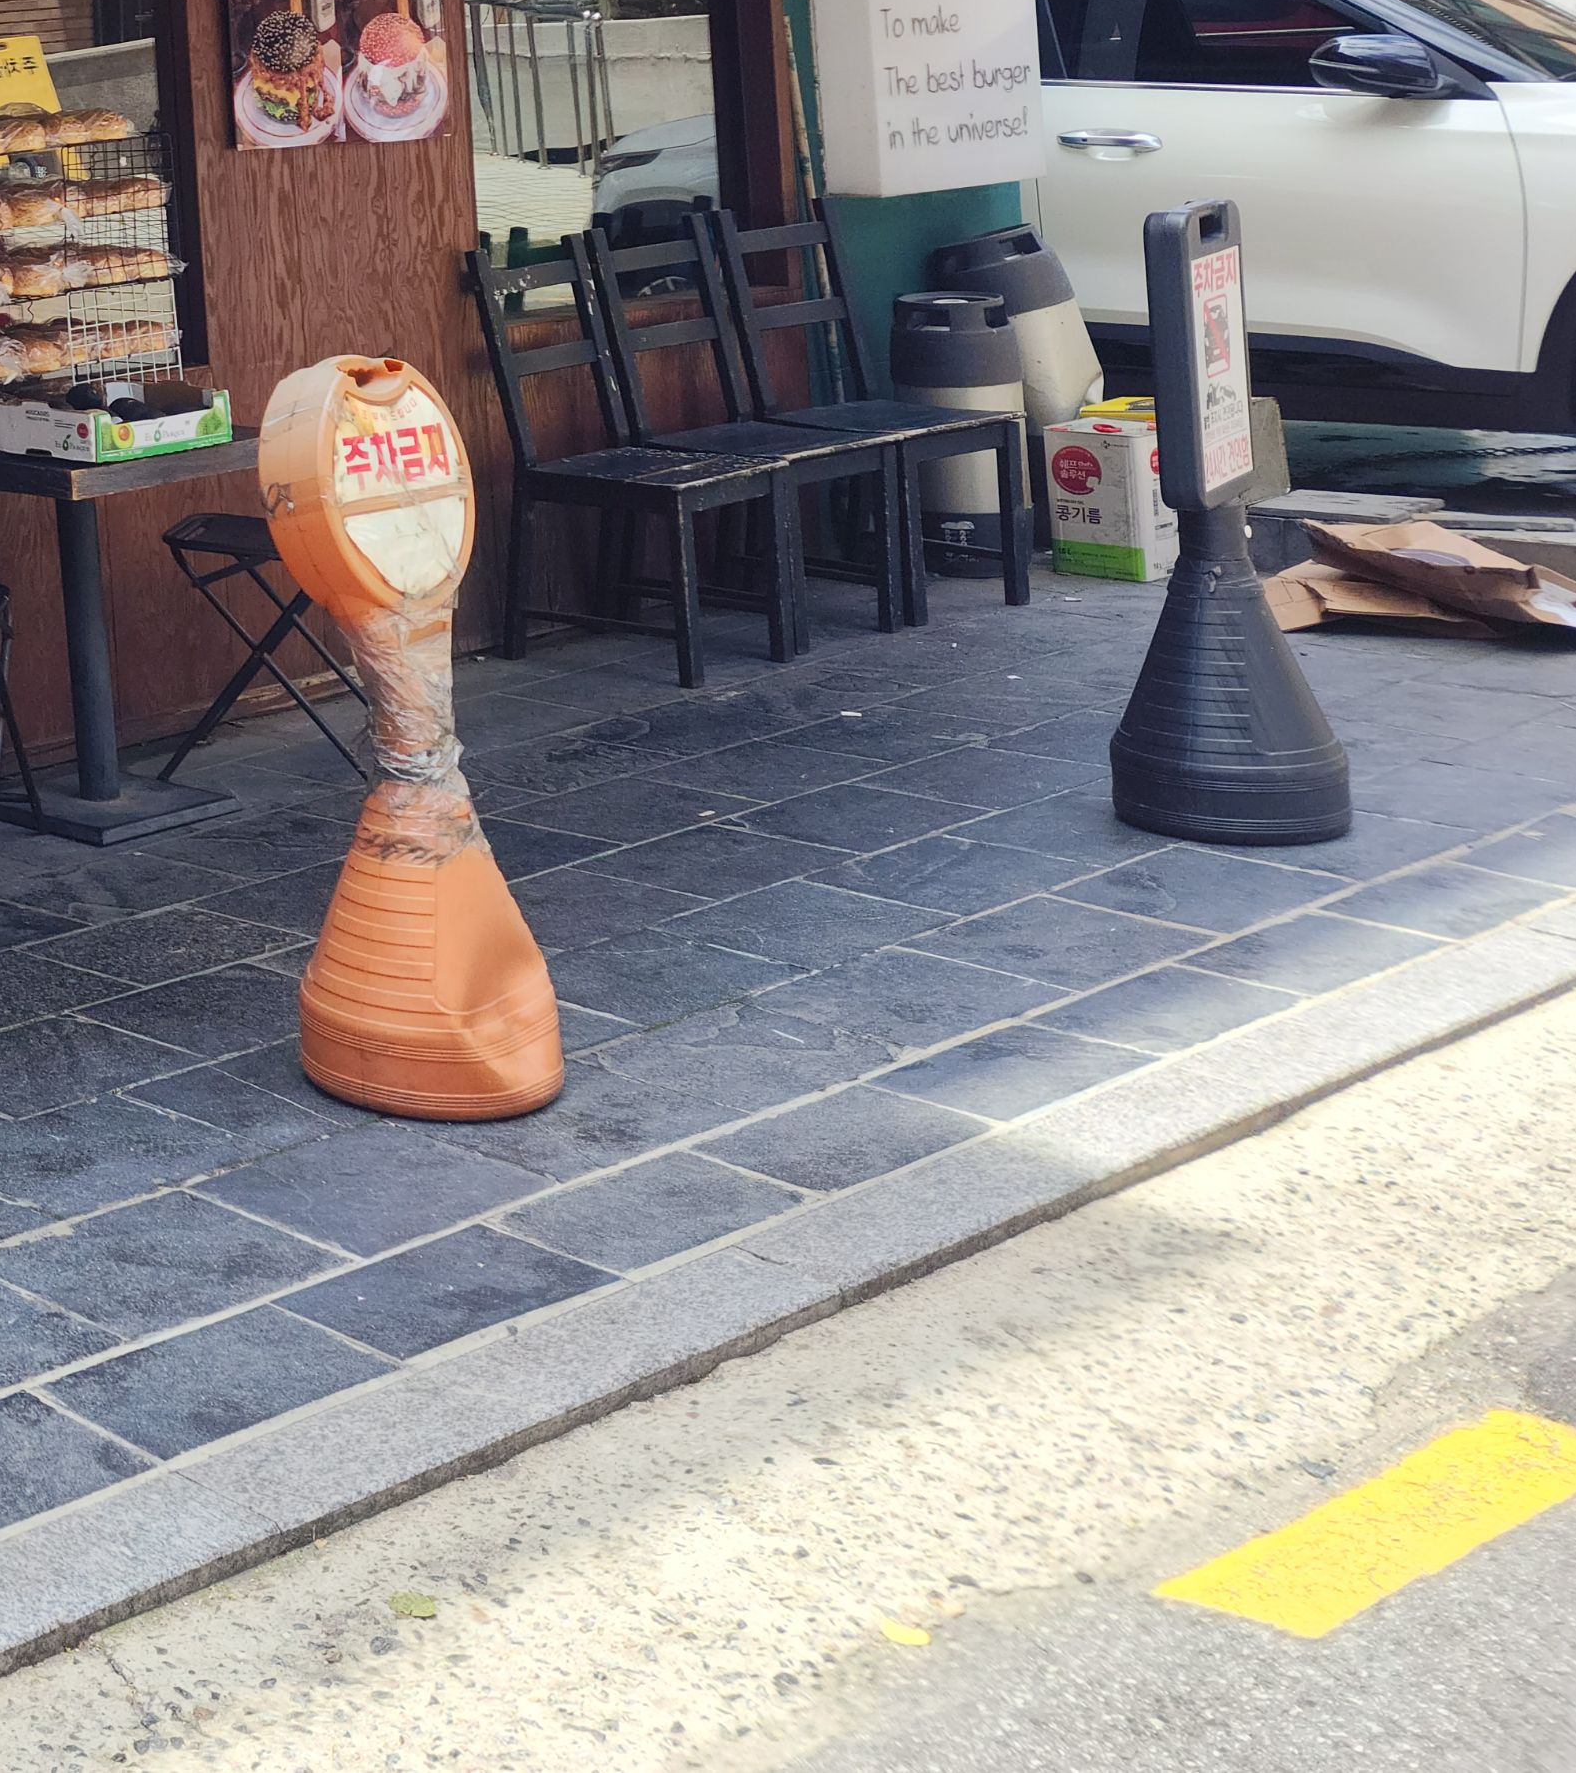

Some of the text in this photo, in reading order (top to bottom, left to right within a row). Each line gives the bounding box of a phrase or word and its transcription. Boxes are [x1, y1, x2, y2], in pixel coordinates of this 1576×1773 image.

[879, 5, 961, 39] To make
[883, 59, 1030, 97] The best burger
[888, 106, 1029, 150] in the universe!
[1193, 249, 1237, 299] 주차금지
[342, 422, 451, 492] 주차금지
[1060, 469, 1087, 481] 솔루션
[1055, 503, 1103, 525] 콩기름
